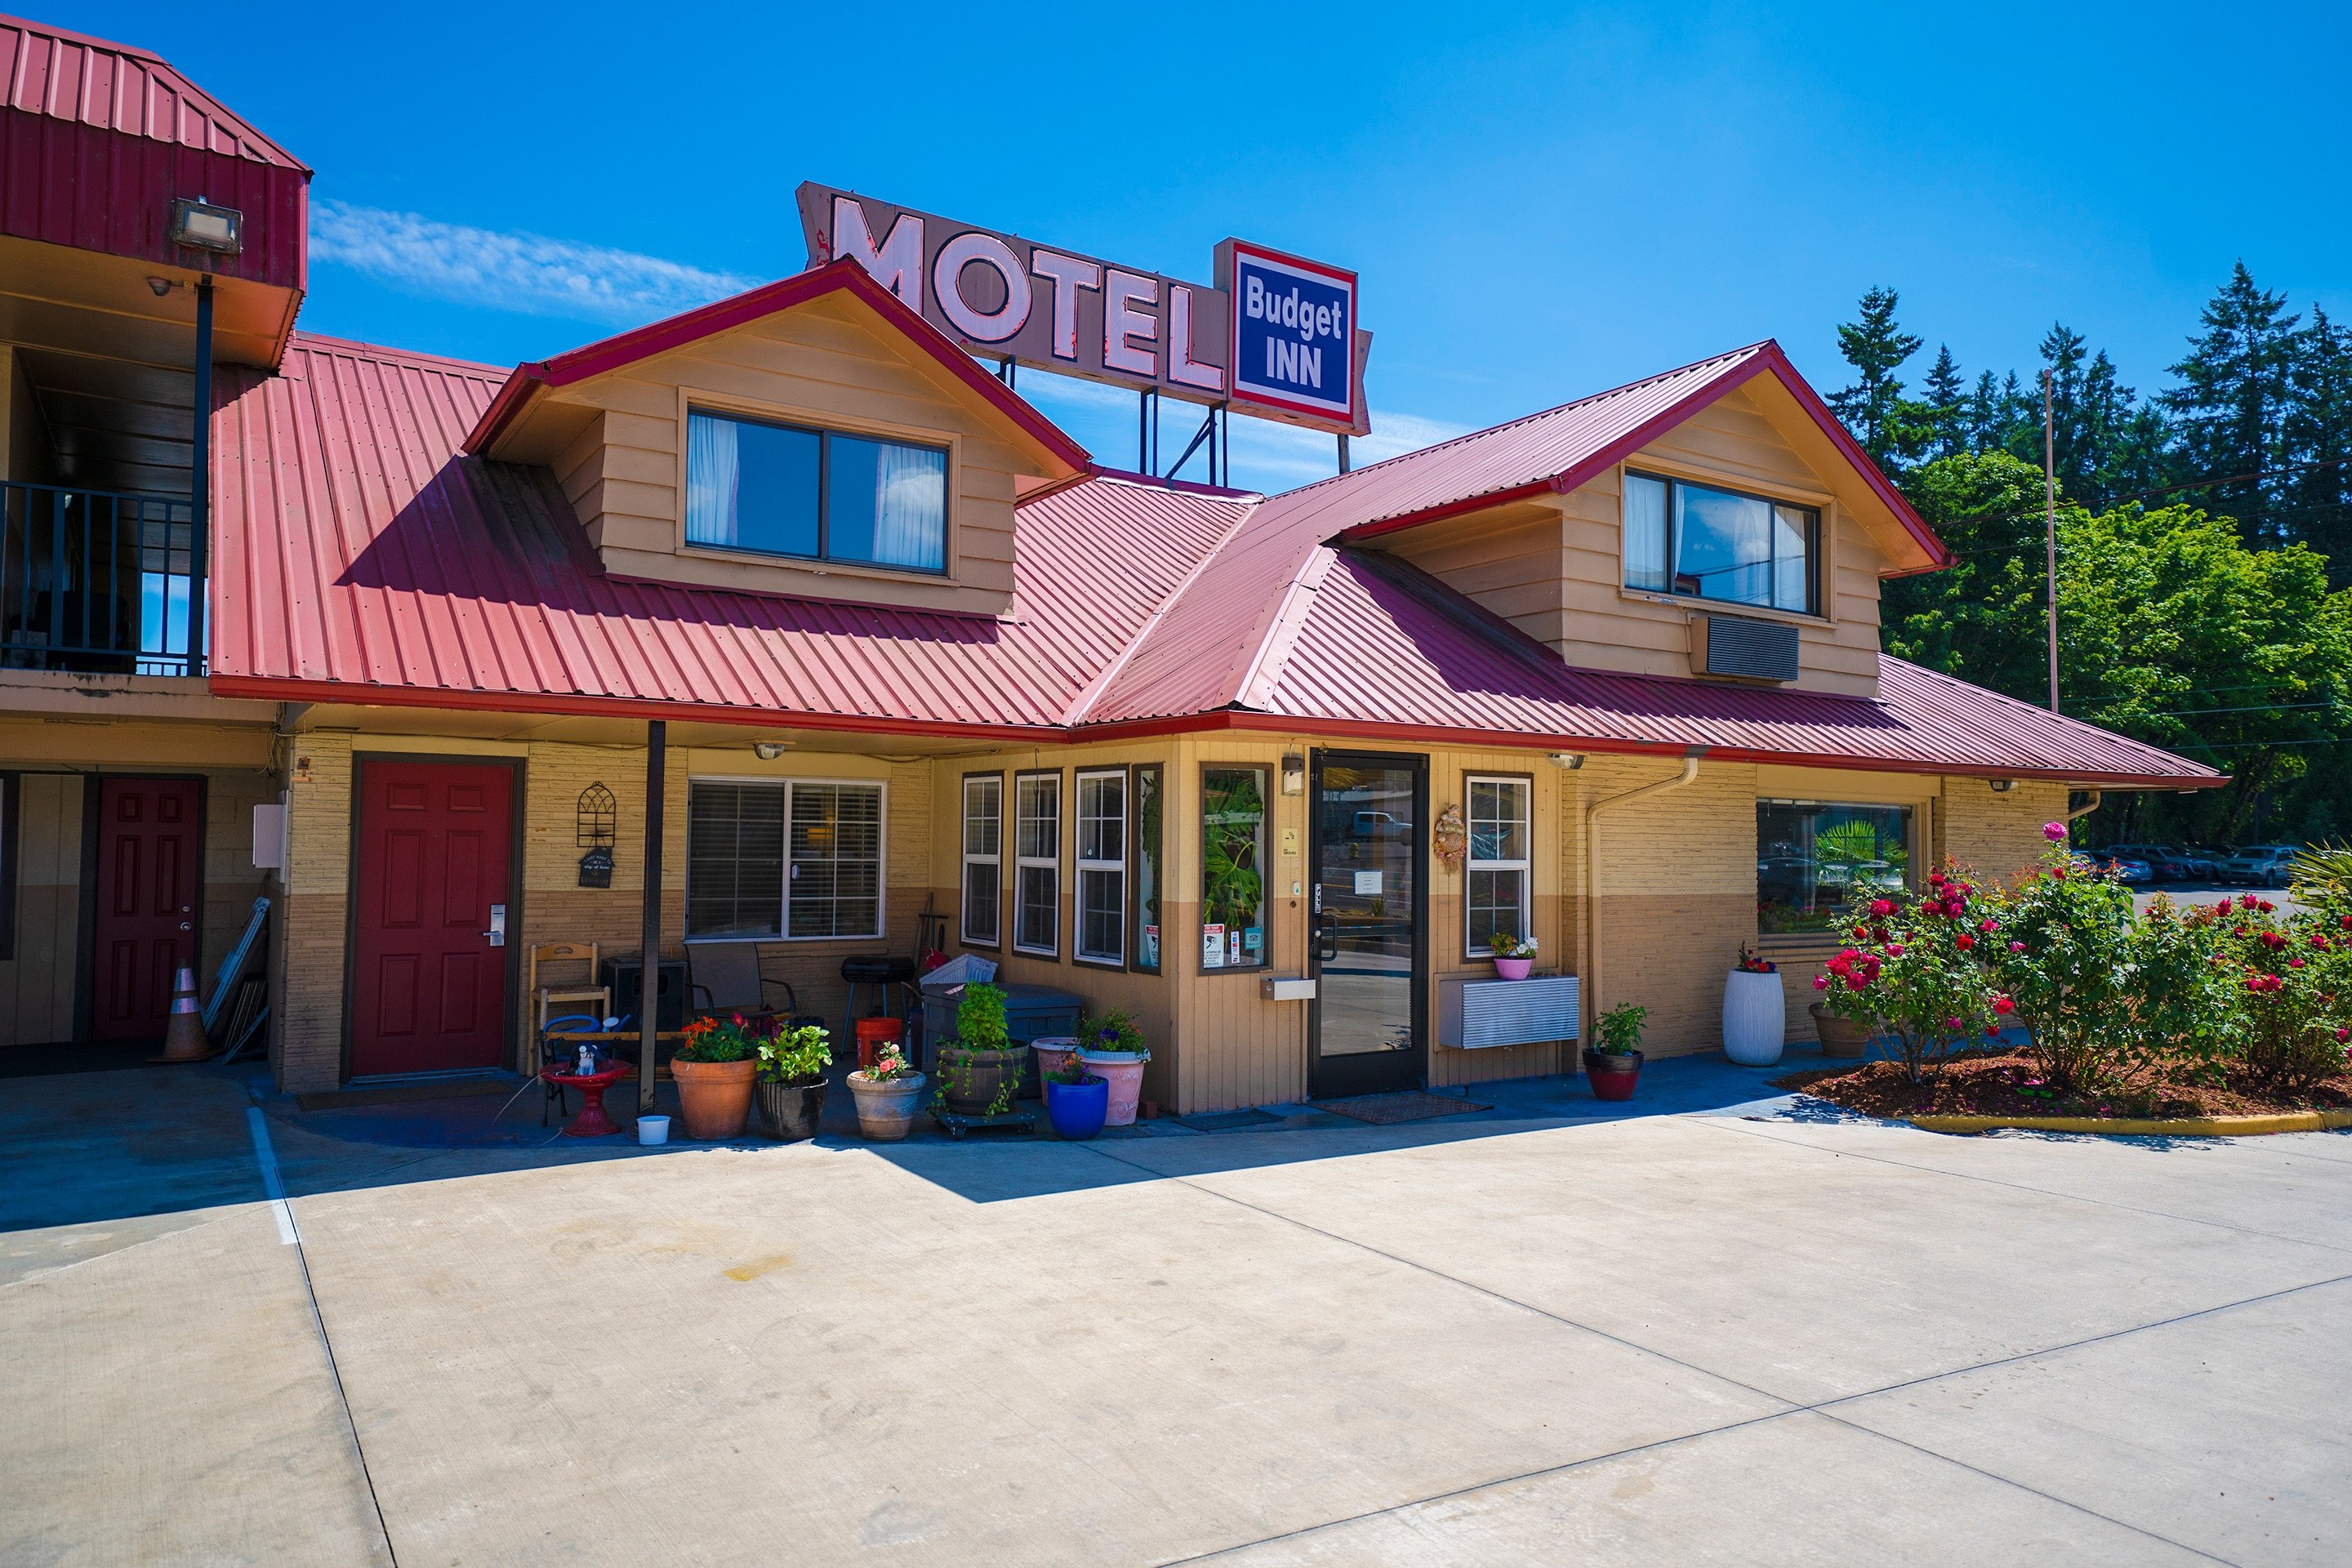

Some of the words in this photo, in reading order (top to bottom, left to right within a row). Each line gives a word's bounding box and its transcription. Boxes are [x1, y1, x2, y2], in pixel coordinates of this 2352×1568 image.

[831, 194, 1225, 391] MOTEL
[1246, 274, 1342, 341] Budget
[1267, 336, 1321, 389] INN
